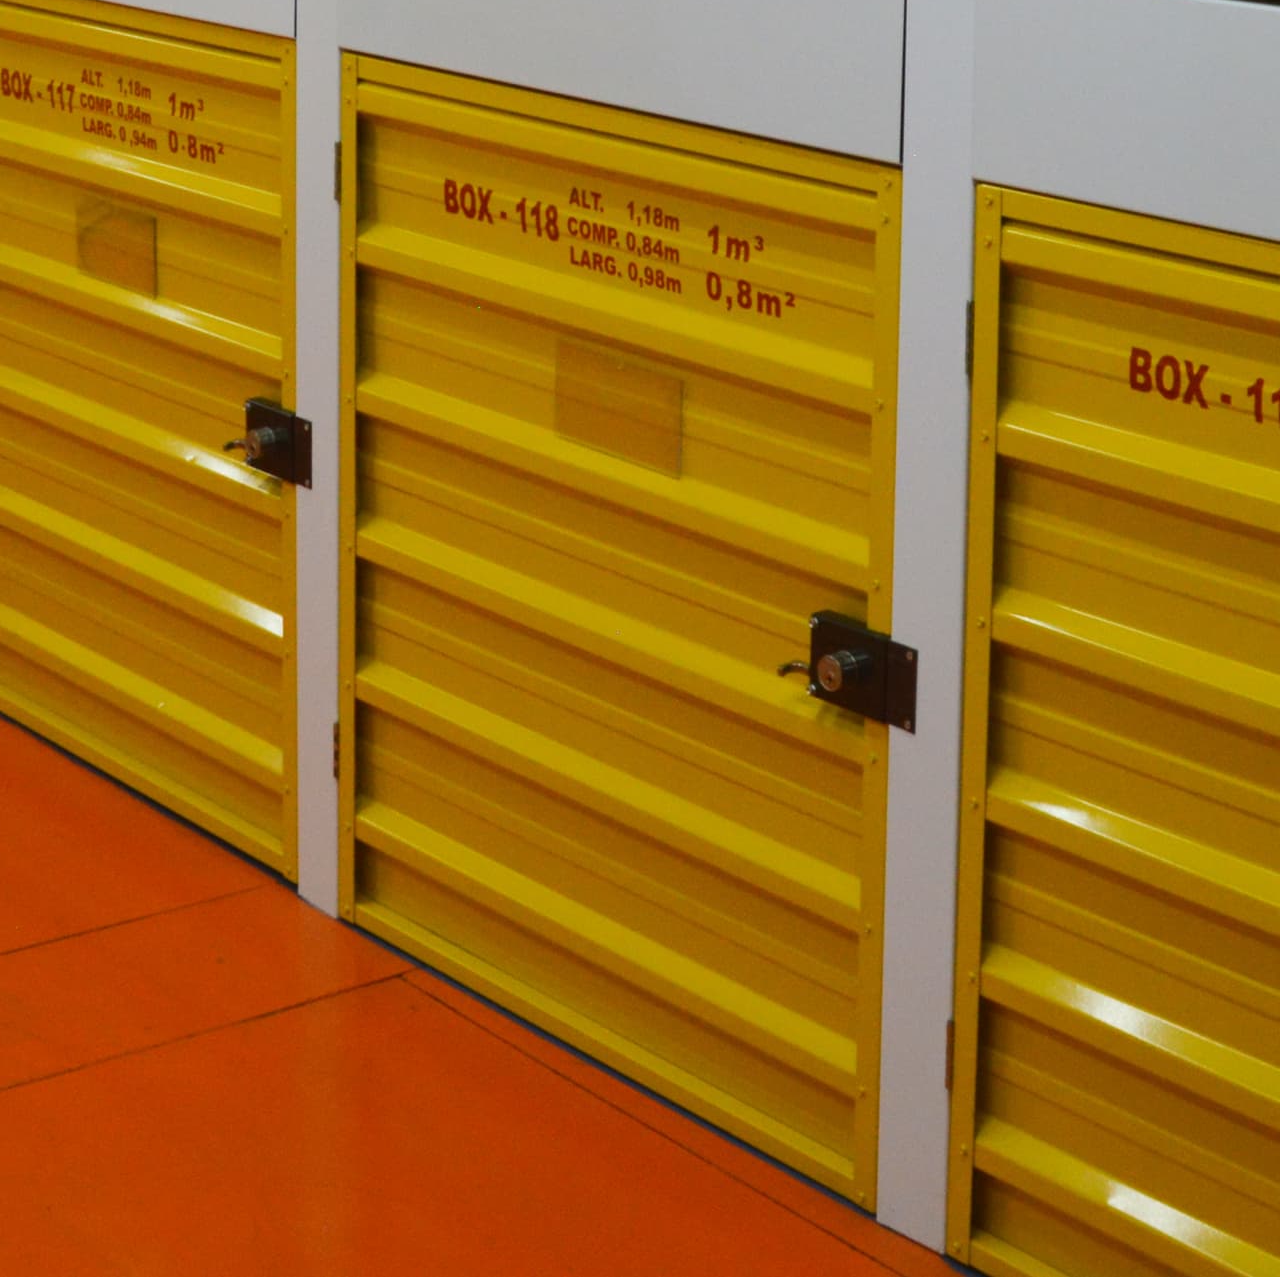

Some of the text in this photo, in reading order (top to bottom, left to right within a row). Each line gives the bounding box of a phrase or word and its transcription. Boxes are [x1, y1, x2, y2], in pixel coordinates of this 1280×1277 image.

[1, 67, 34, 103] BOX
[47, 79, 76, 114] 117
[81, 68, 104, 88] ALT.
[80, 92, 114, 116] COMP.
[83, 117, 116, 140] LARG.
[444, 179, 493, 225] BOX
[516, 197, 560, 242] 118
[569, 187, 680, 233] ALT. 1,18m
[567, 217, 680, 264] COMP. 0,84m
[707, 225, 765, 263] 1m³
[569, 246, 682, 295] LARG. 0,98m
[1129, 347, 1209, 409] BOX
